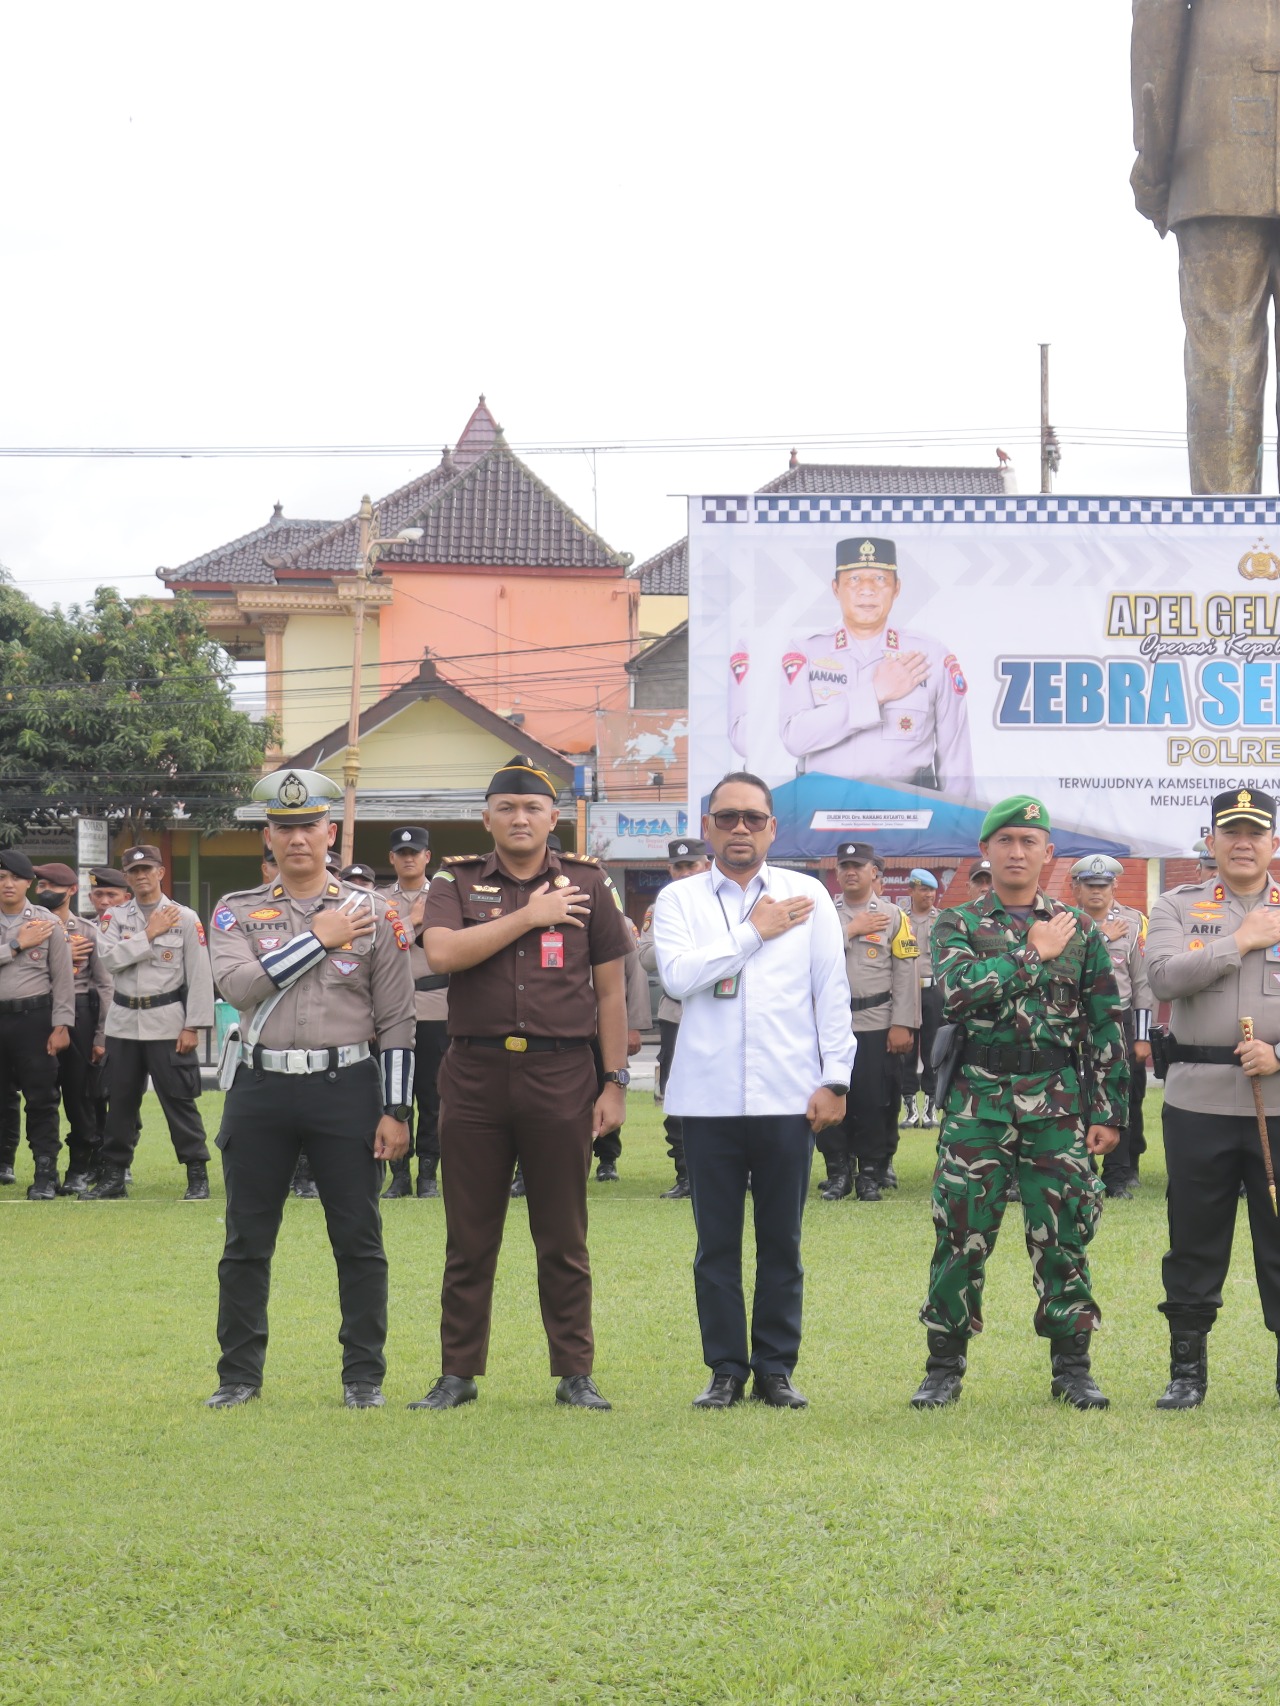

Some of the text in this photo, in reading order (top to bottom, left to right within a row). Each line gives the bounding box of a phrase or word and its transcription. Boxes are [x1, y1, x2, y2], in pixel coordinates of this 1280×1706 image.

[1107, 595, 1199, 637] APEL
[1140, 633, 1218, 664] Operasi
[999, 660, 1191, 725] ZEBRA
[1058, 777, 1154, 790] TERWUJUDNYA
[617, 811, 673, 837] PIZZA
[1191, 924, 1222, 935] ARIF
